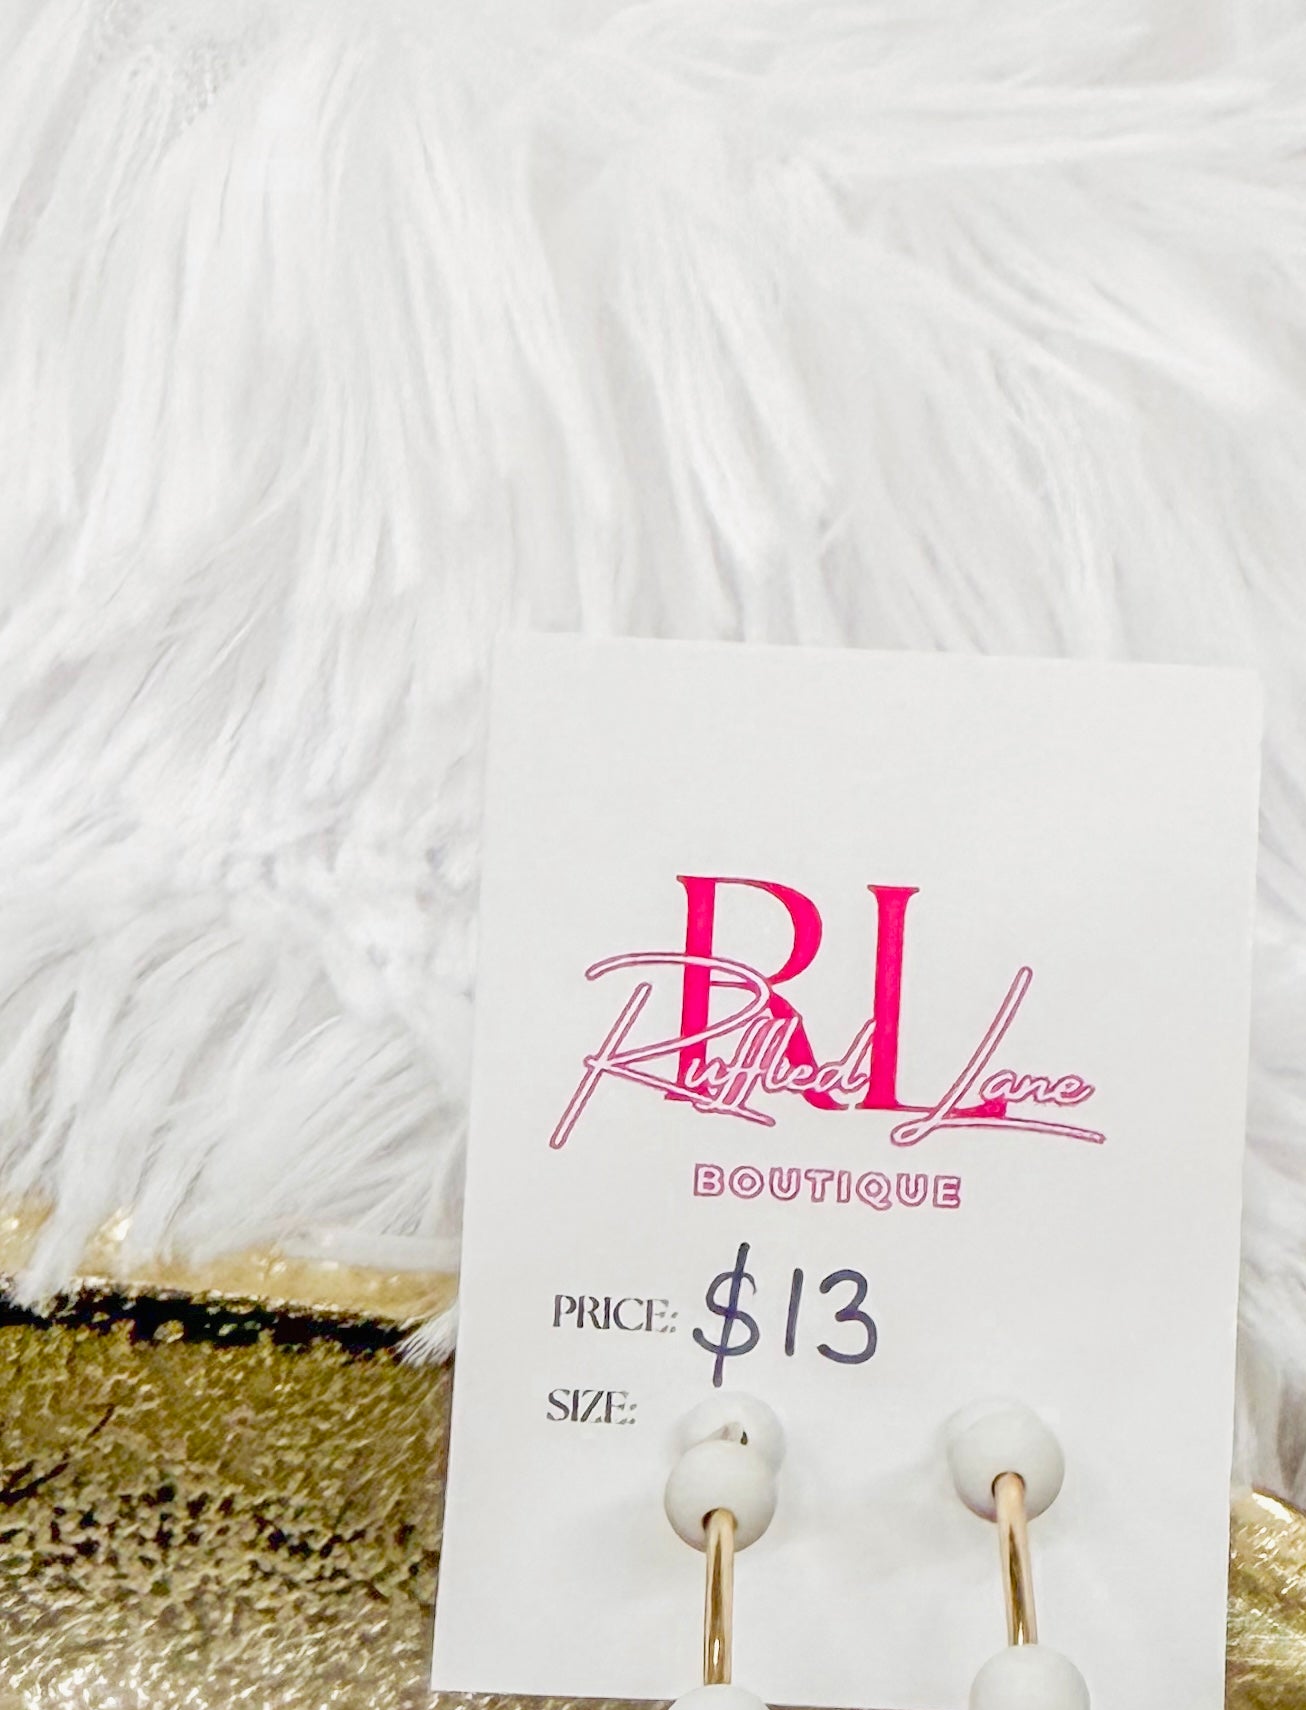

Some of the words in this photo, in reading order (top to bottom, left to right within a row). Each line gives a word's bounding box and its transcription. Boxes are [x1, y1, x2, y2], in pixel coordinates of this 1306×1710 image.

[548, 951, 876, 1149] Ruffled
[890, 966, 1107, 1147] Lane
[693, 1163, 962, 1211] BOUTIQUE
[551, 1293, 679, 1335] PRICE:
[691, 1241, 879, 1388] $13
[545, 1387, 637, 1426] SIZE:
